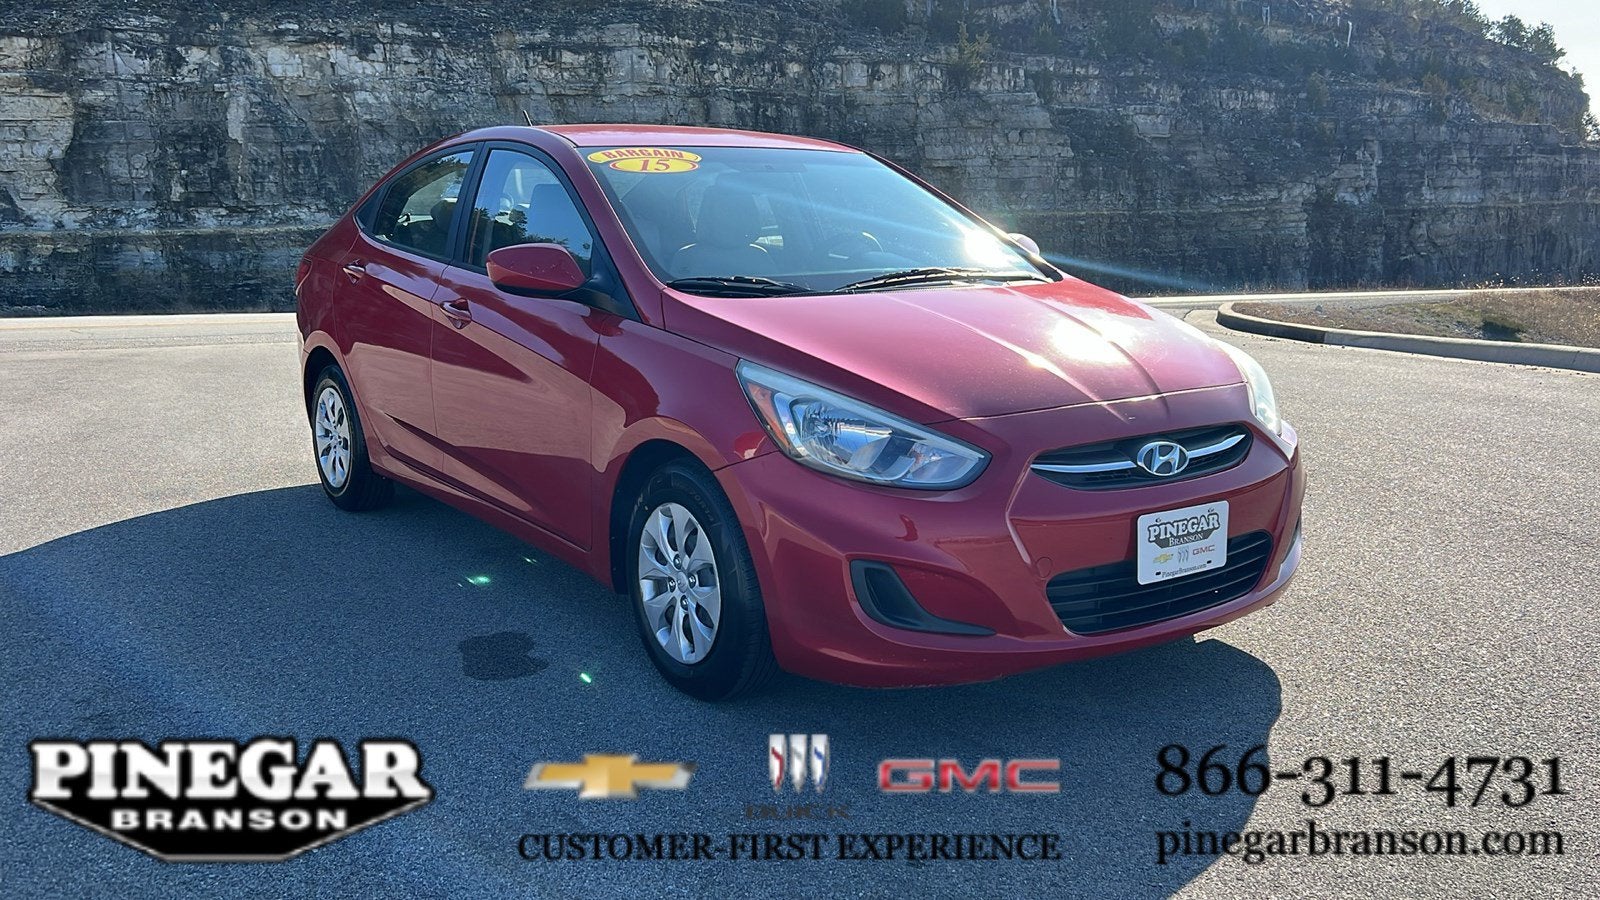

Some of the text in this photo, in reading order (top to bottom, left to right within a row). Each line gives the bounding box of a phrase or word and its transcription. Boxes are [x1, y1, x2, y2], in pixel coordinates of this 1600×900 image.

[601, 148, 684, 159] BARGAIN
[640, 160, 671, 171] 15
[1149, 514, 1219, 541] PINEGAR
[1169, 533, 1204, 546] BRANSON
[1193, 545, 1216, 555] GMC
